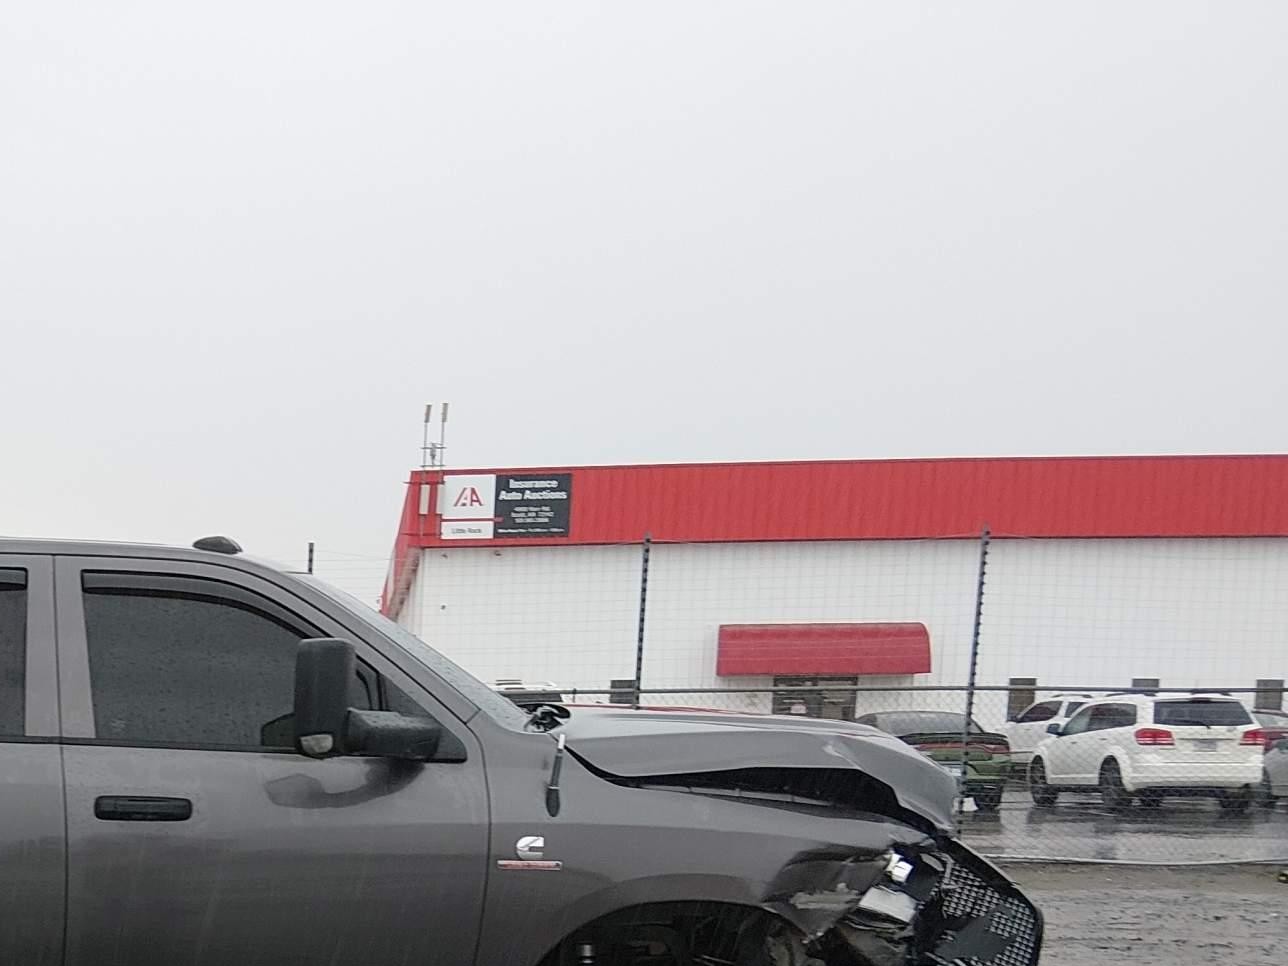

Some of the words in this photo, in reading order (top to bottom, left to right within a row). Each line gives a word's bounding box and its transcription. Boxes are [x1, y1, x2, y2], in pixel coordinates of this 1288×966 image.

[509, 479, 558, 488] Insurance
[499, 490, 522, 500] Auto
[524, 490, 567, 499] Auctions
